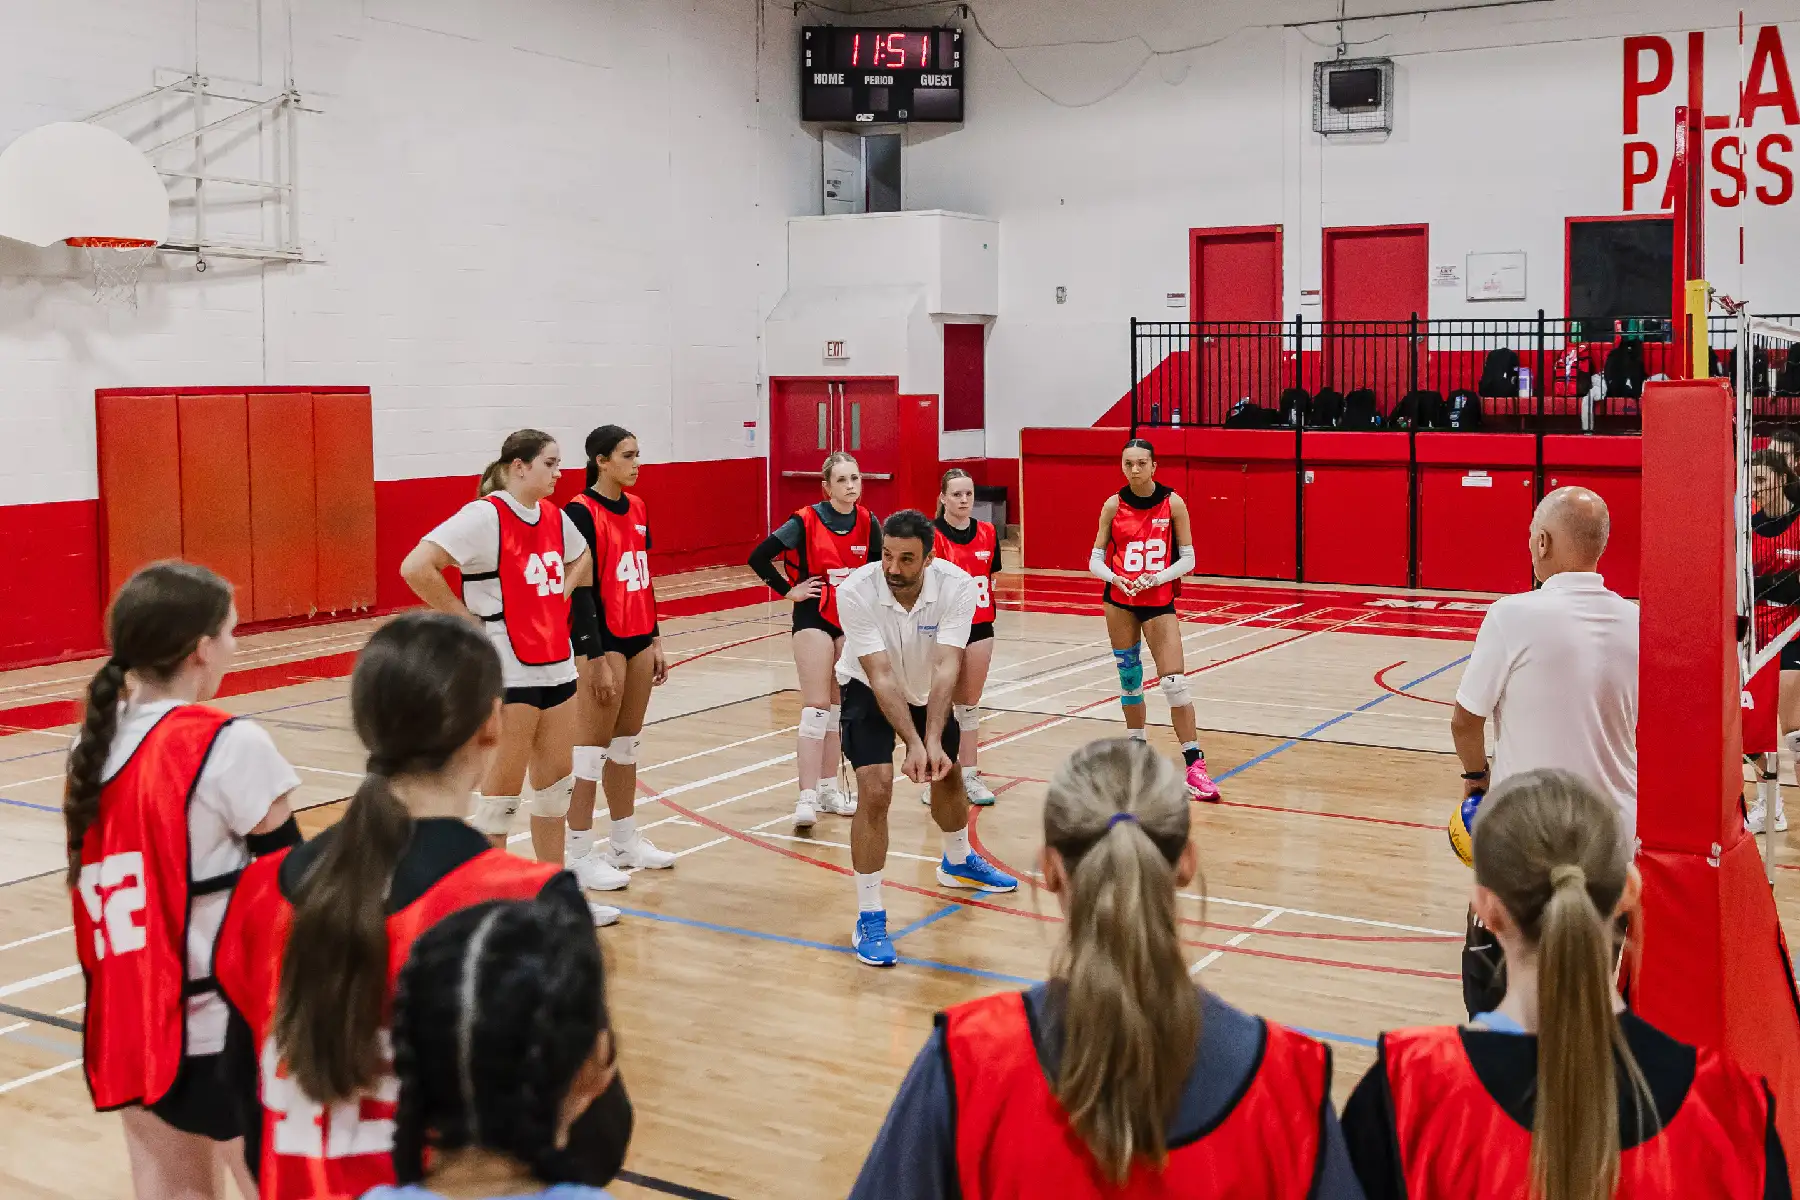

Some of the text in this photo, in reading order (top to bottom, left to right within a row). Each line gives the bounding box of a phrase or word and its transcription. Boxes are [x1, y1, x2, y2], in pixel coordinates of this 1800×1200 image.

[853, 33, 928, 68] 11:51
[813, 73, 845, 85] HOME
[864, 75, 894, 85] PERIOD
[920, 74, 953, 86] GUEST
[1623, 26, 1800, 134] PLA
[827, 341, 844, 357] EXIT
[616, 550, 650, 592] 40
[1124, 539, 1167, 572] 62
[523, 551, 565, 597] 43
